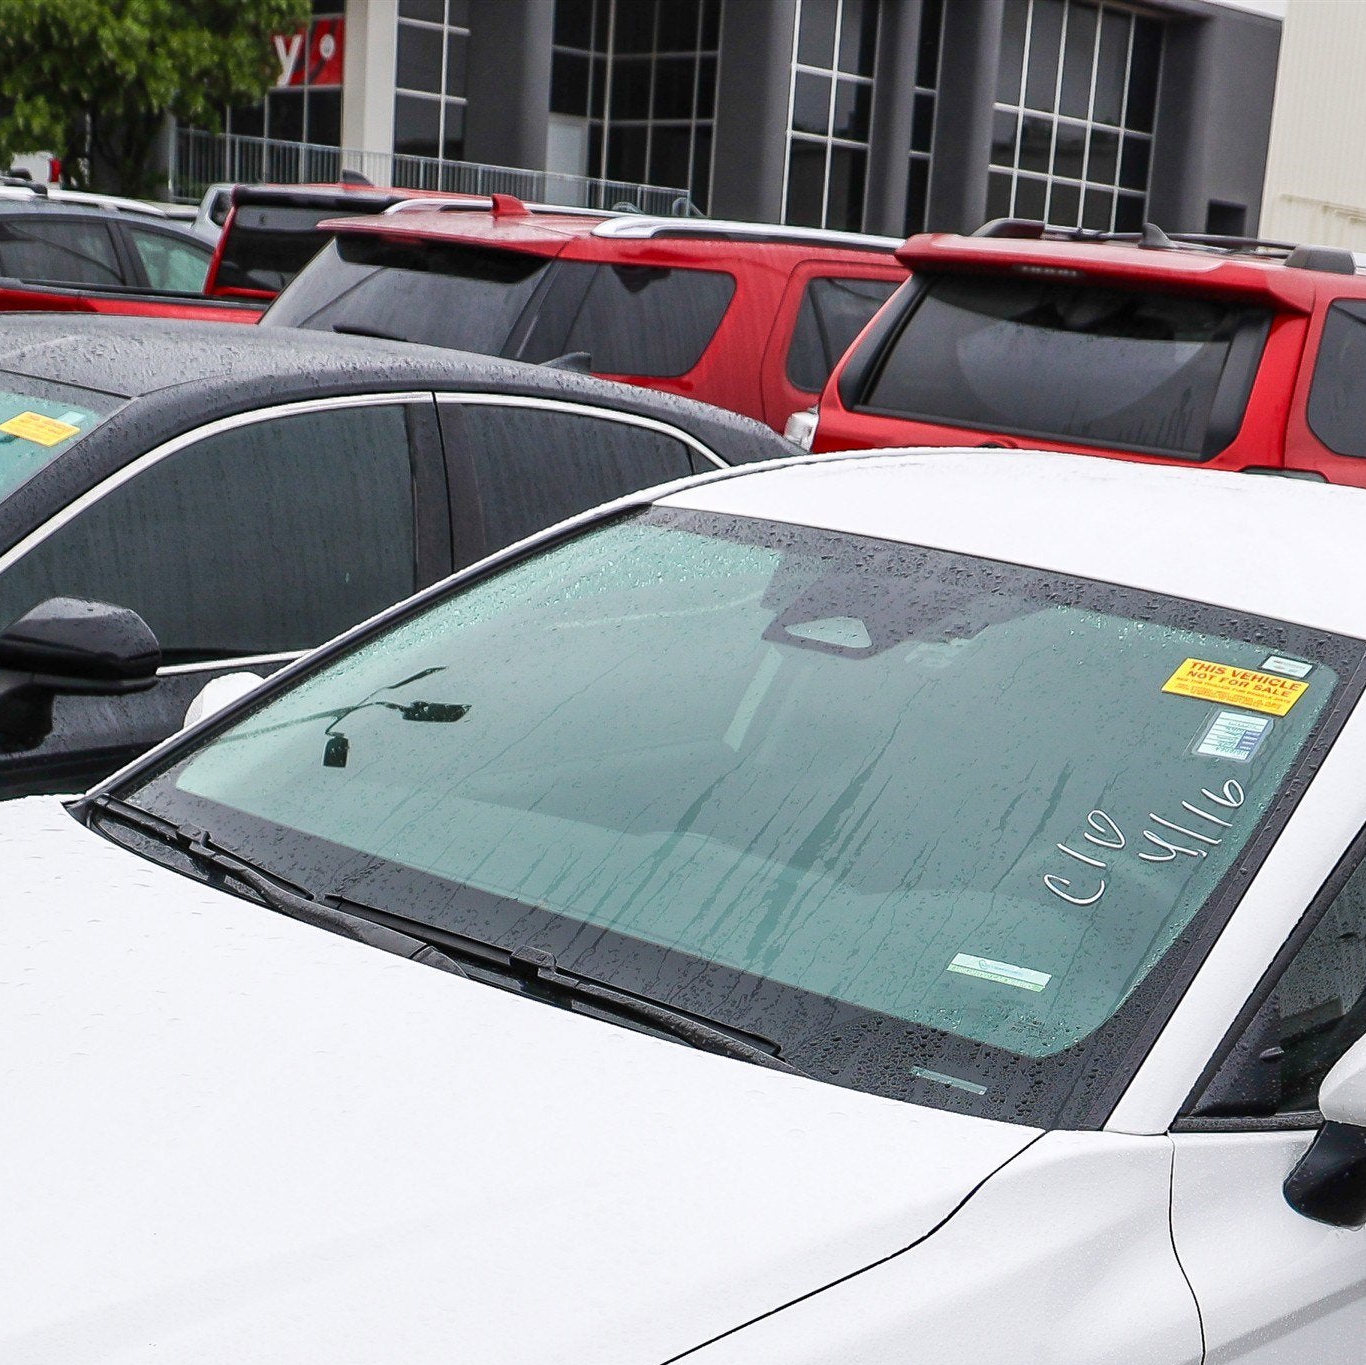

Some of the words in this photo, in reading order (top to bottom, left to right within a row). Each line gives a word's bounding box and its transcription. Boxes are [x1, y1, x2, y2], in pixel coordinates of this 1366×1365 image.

[1186, 671, 1217, 681] NOT
[1219, 677, 1250, 688] FOR
[1253, 685, 1292, 697] SALE
[1191, 662, 1227, 675] THIS
[1232, 670, 1302, 692] VEHICLE
